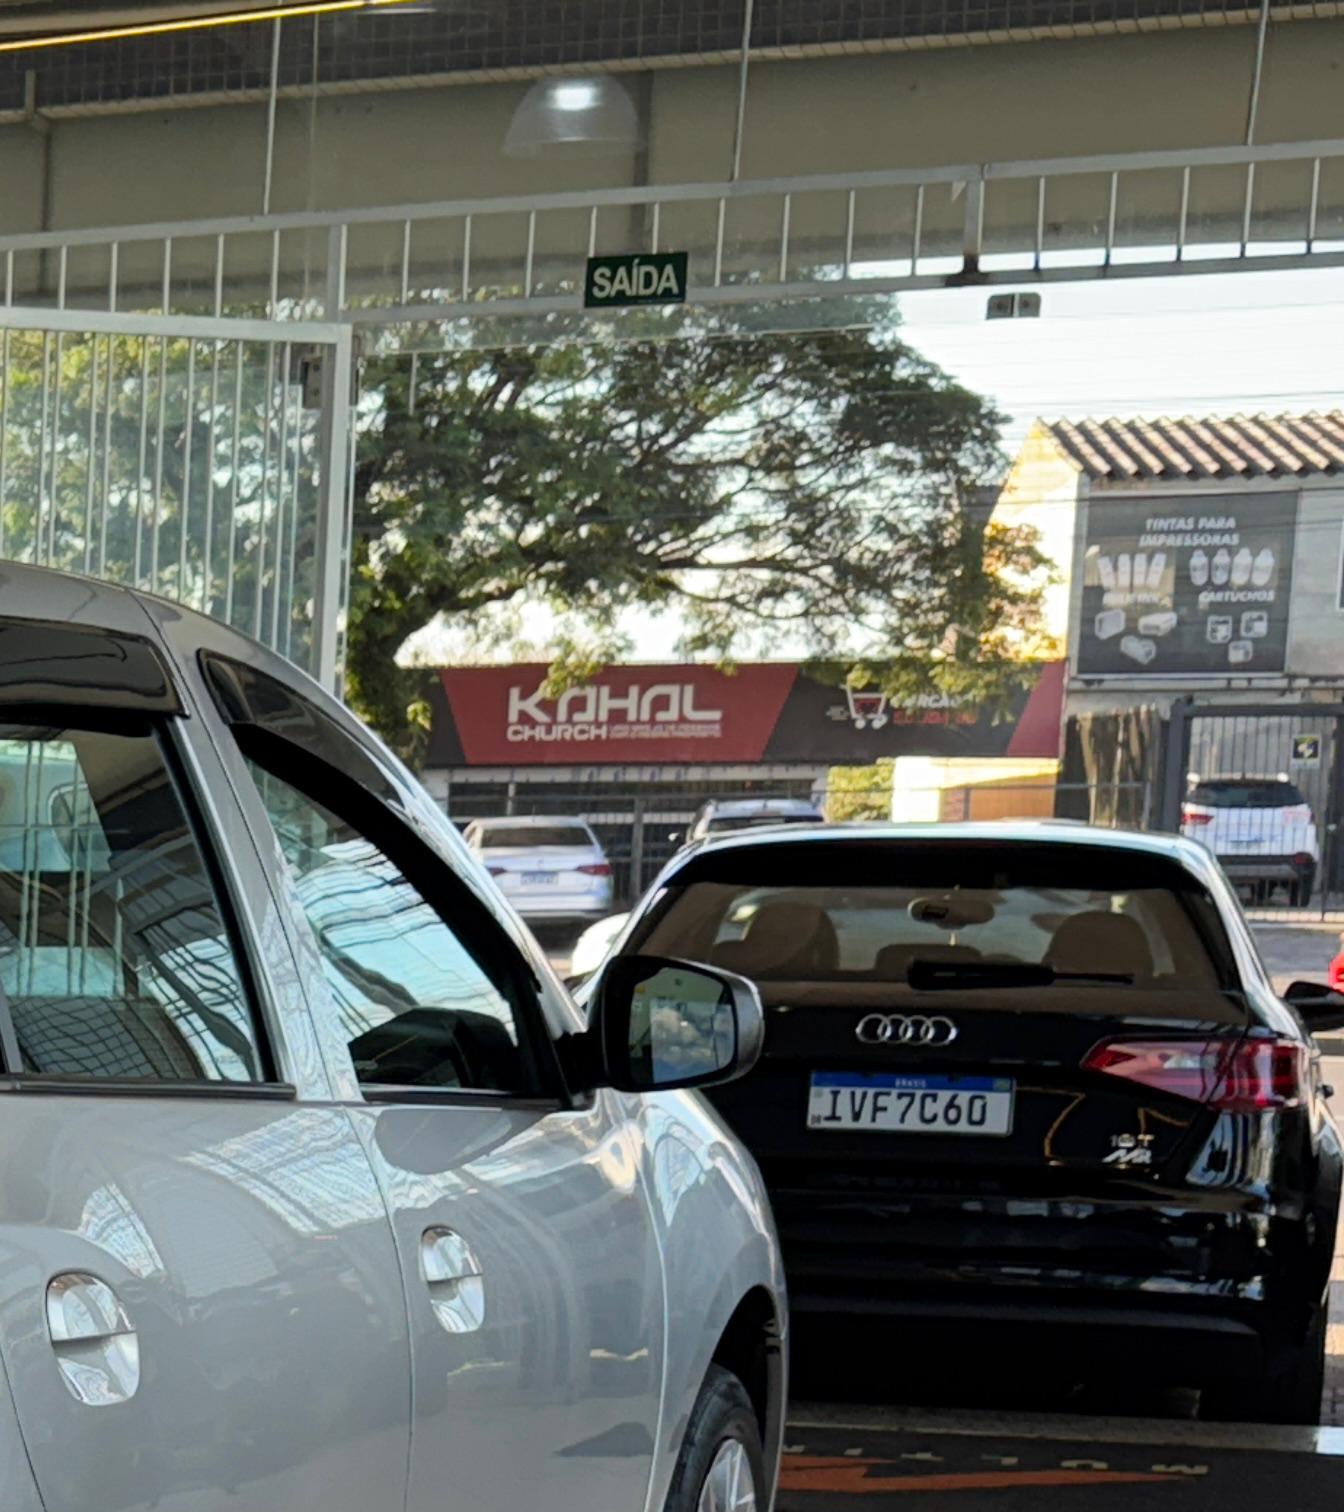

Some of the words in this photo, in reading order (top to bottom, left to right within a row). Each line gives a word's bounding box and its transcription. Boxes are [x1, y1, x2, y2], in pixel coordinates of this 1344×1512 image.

[592, 258, 679, 299] SAÍDA
[1146, 517, 1194, 531] TINTAS
[1198, 516, 1237, 530] PARA
[1139, 533, 1240, 547] IMPRESSORAS
[508, 684, 723, 724] KAHAL
[507, 723, 608, 742] CHURCH
[823, 1089, 988, 1127] IVF7C60
